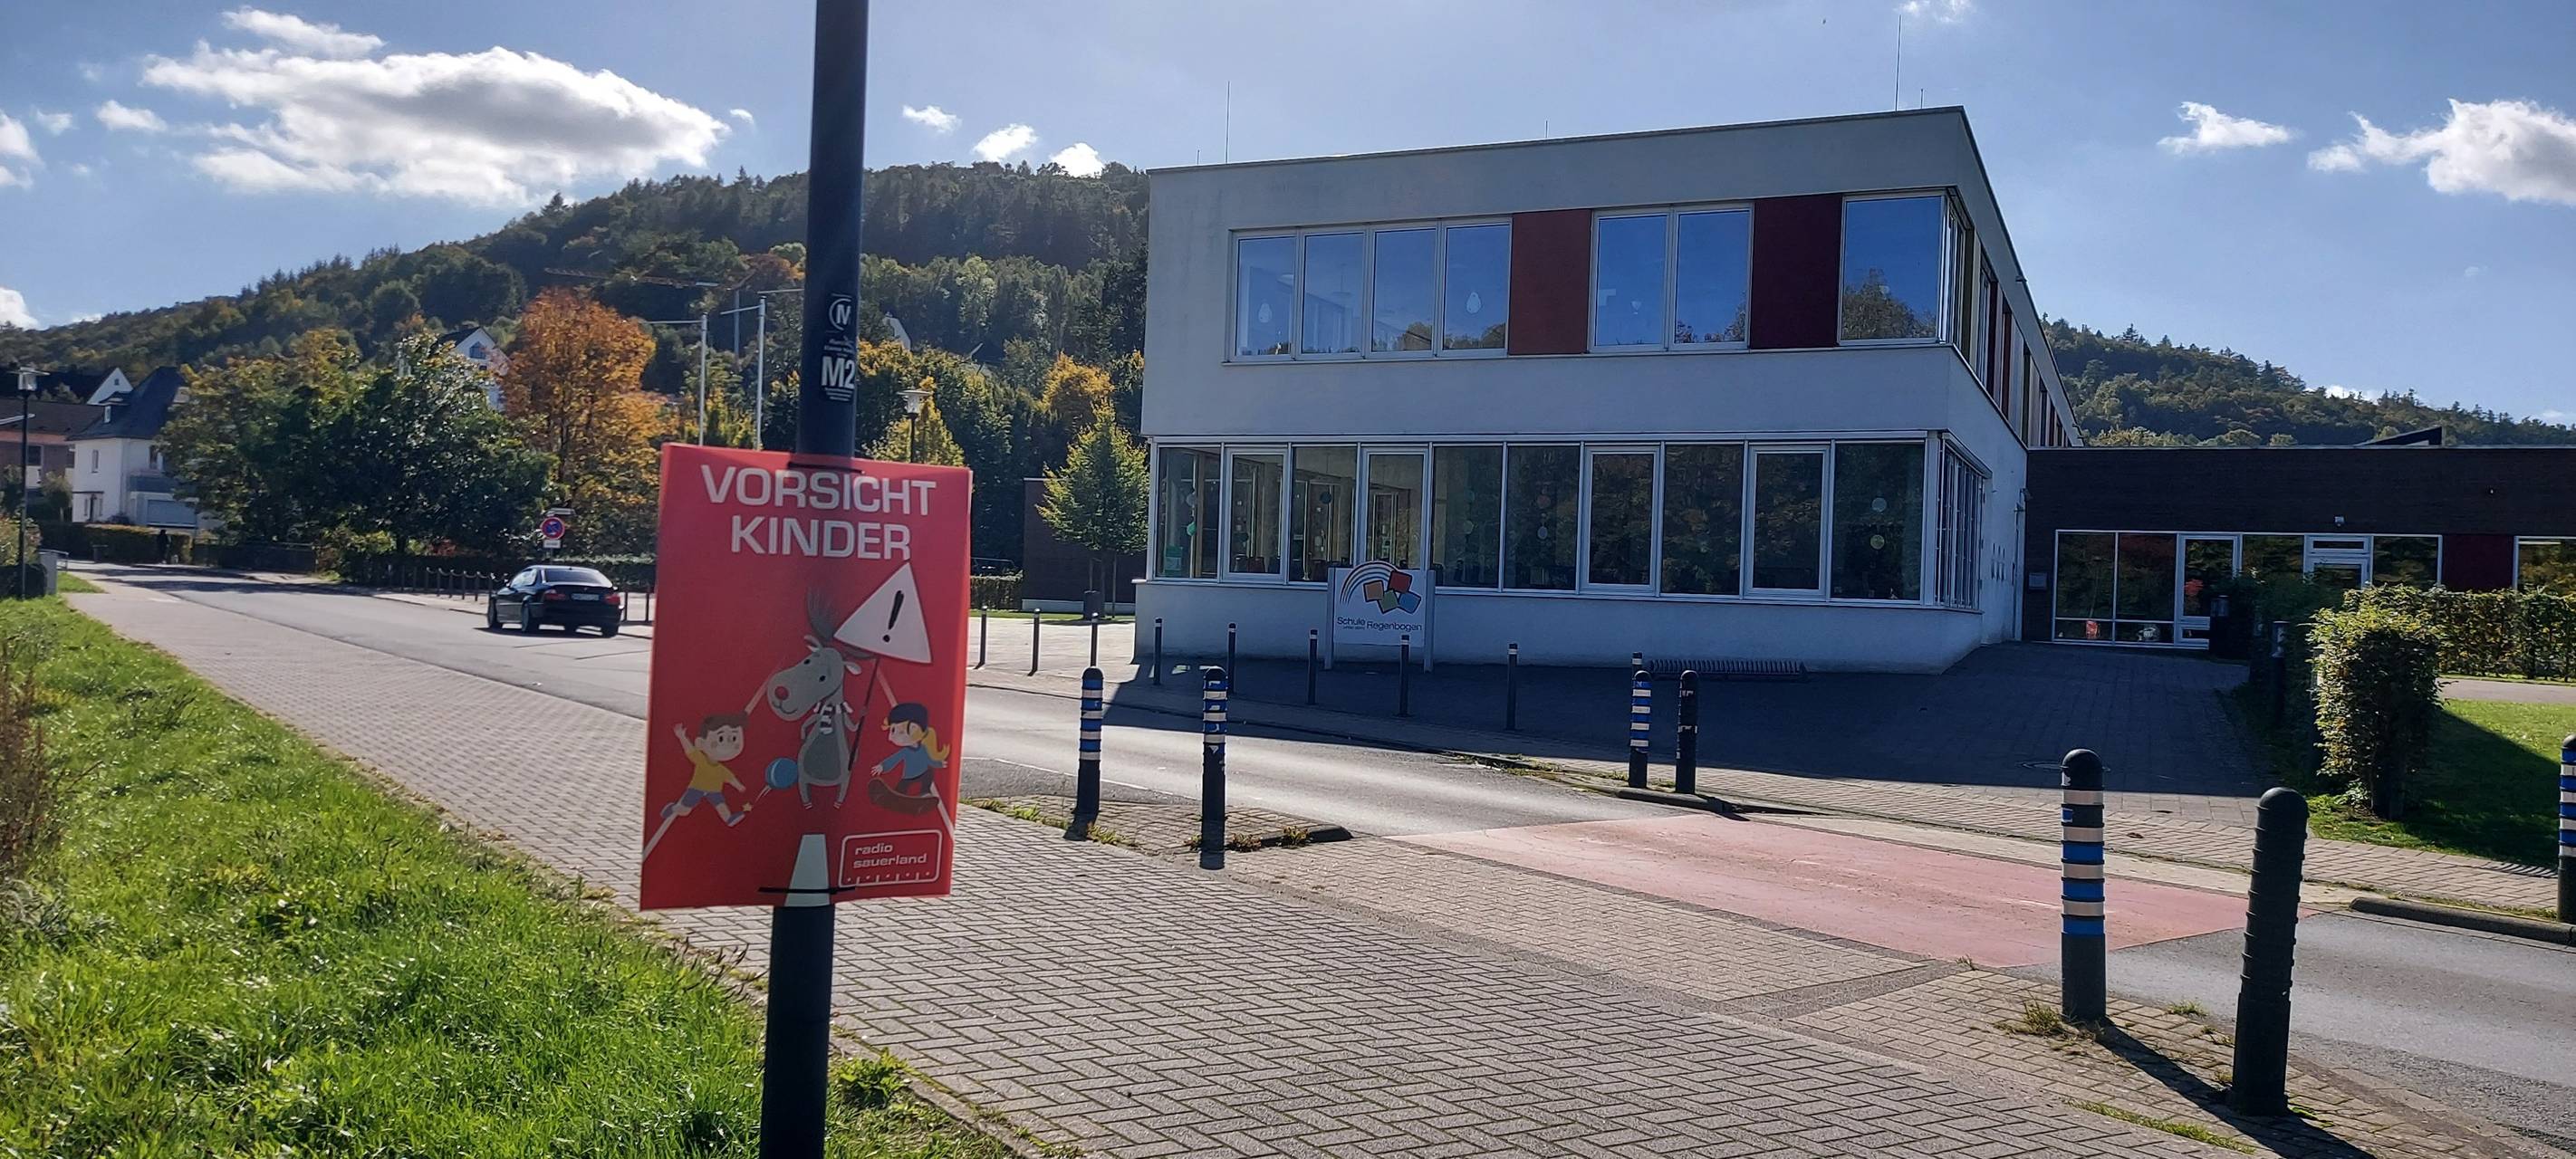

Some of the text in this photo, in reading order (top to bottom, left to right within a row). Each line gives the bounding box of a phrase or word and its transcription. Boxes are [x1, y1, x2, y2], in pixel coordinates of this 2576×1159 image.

[822, 356, 855, 389] M2
[701, 465, 937, 516] VORSICHT
[730, 514, 911, 560] KINDER
[1337, 617, 1366, 626] Schule
[1366, 621, 1422, 632] Regenbogen
[853, 853, 928, 868] sauerland
[855, 842, 893, 856] radio
